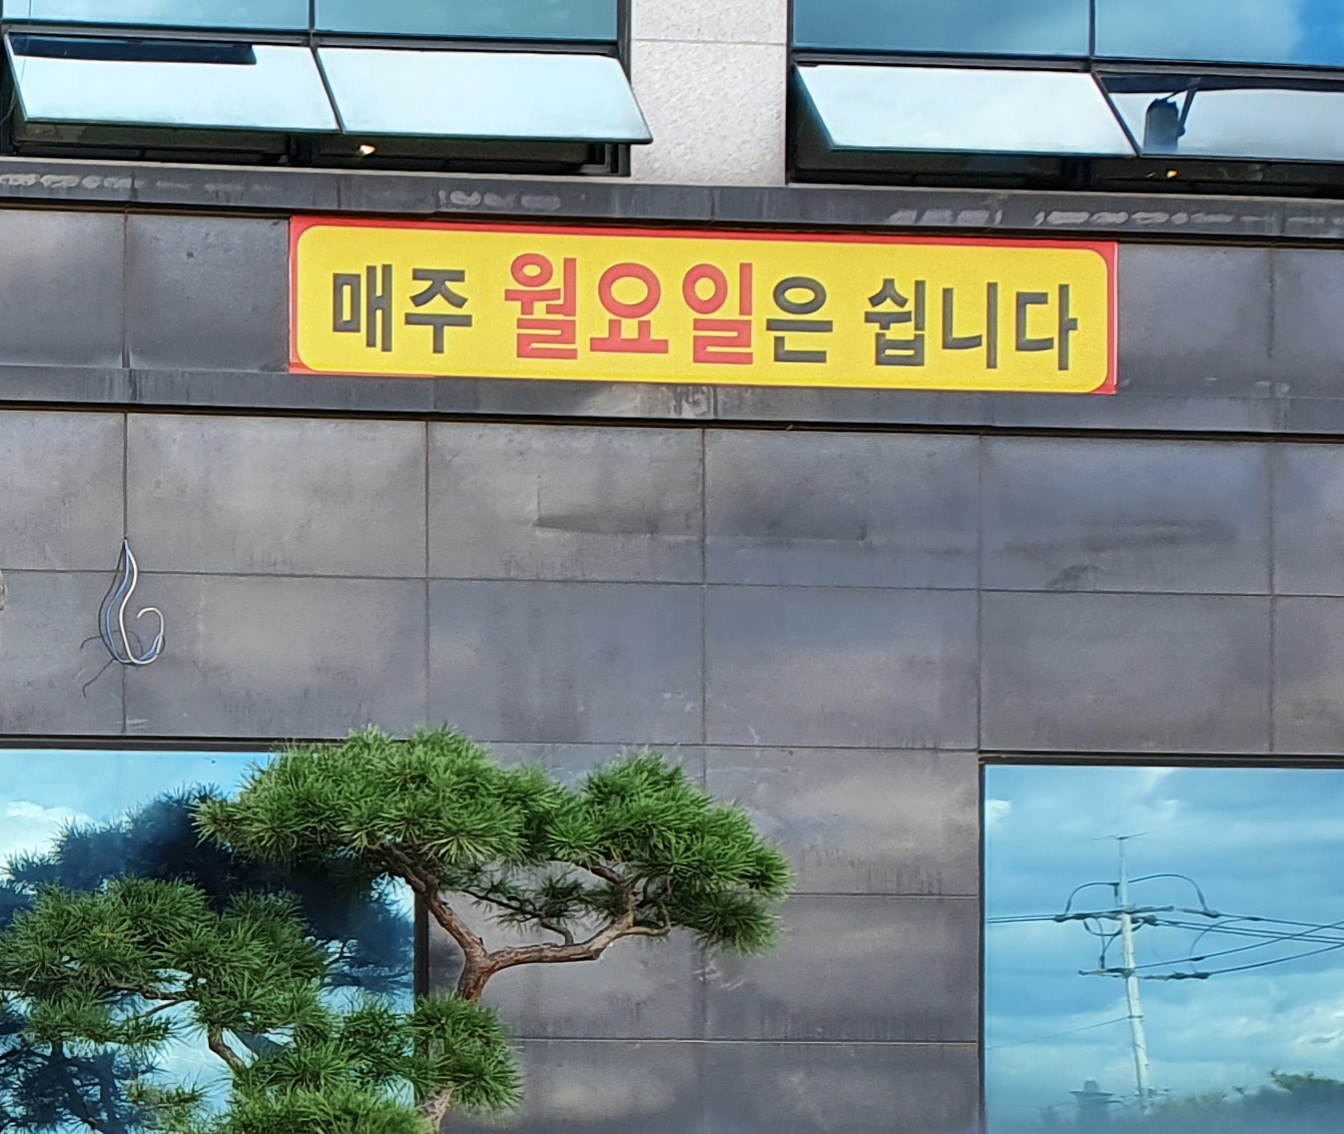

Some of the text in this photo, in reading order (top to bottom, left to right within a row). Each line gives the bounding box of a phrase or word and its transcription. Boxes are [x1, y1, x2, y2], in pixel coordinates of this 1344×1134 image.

[332, 253, 1079, 371] 매주 월요일은 쉽니다
